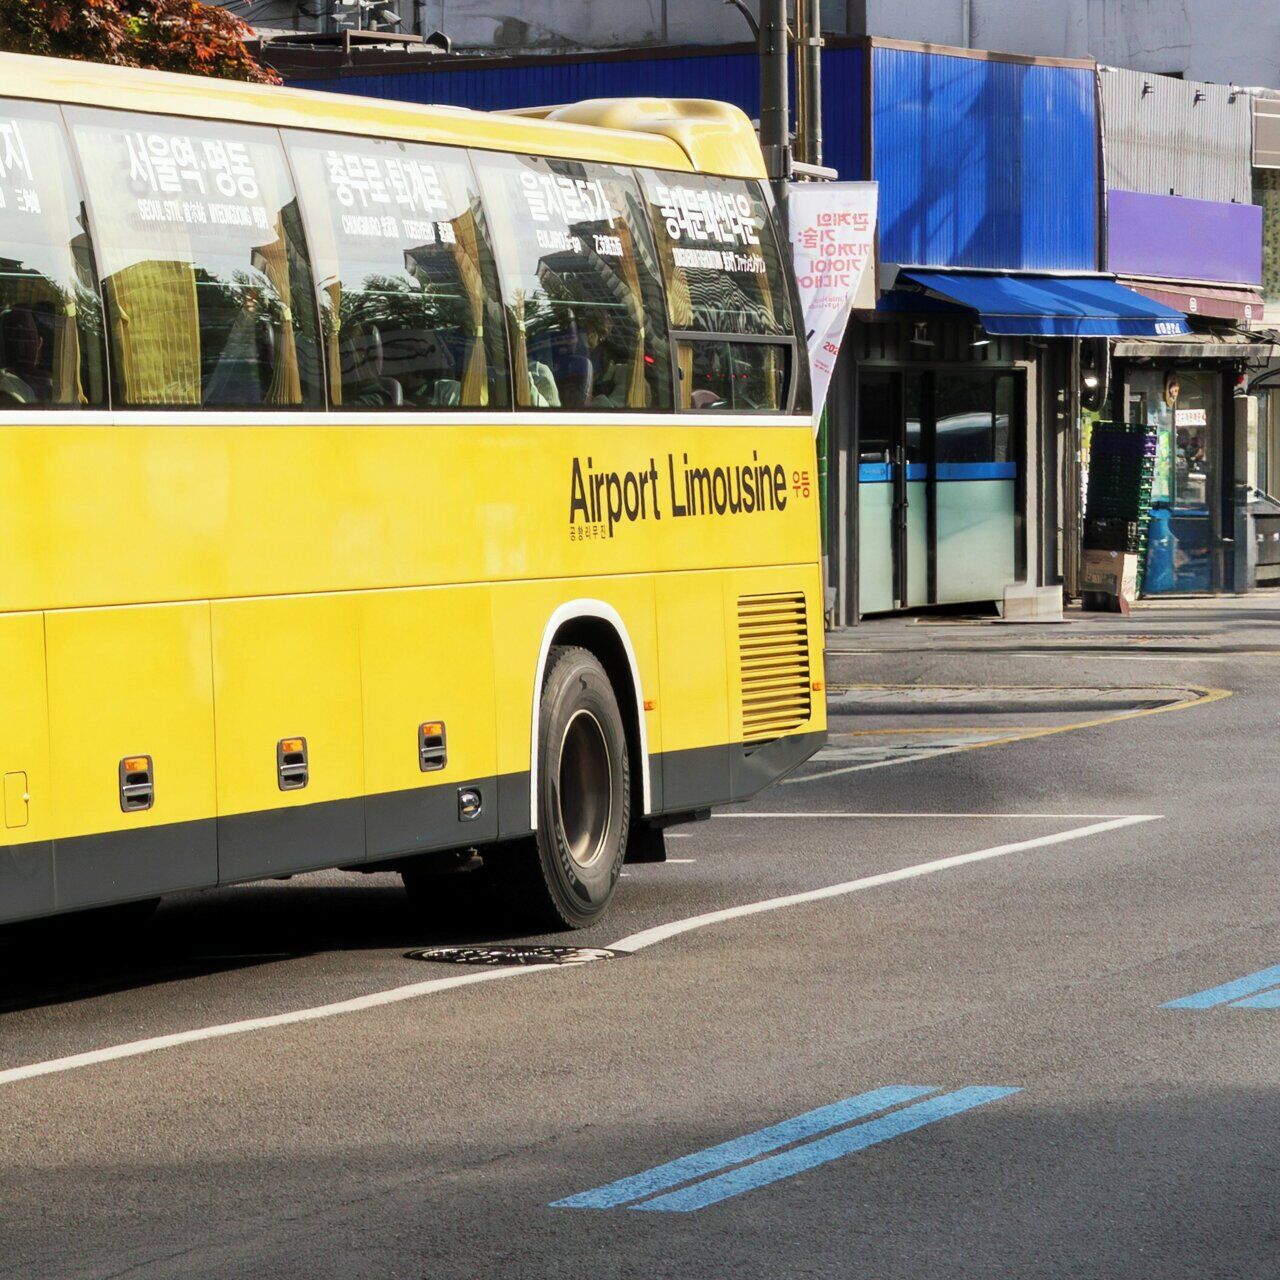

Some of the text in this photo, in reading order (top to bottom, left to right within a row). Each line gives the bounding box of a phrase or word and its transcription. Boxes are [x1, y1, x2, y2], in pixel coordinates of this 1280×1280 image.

[520, 171, 615, 229] 을지로5가
[569, 450, 810, 539] Airport Limousine 우등
